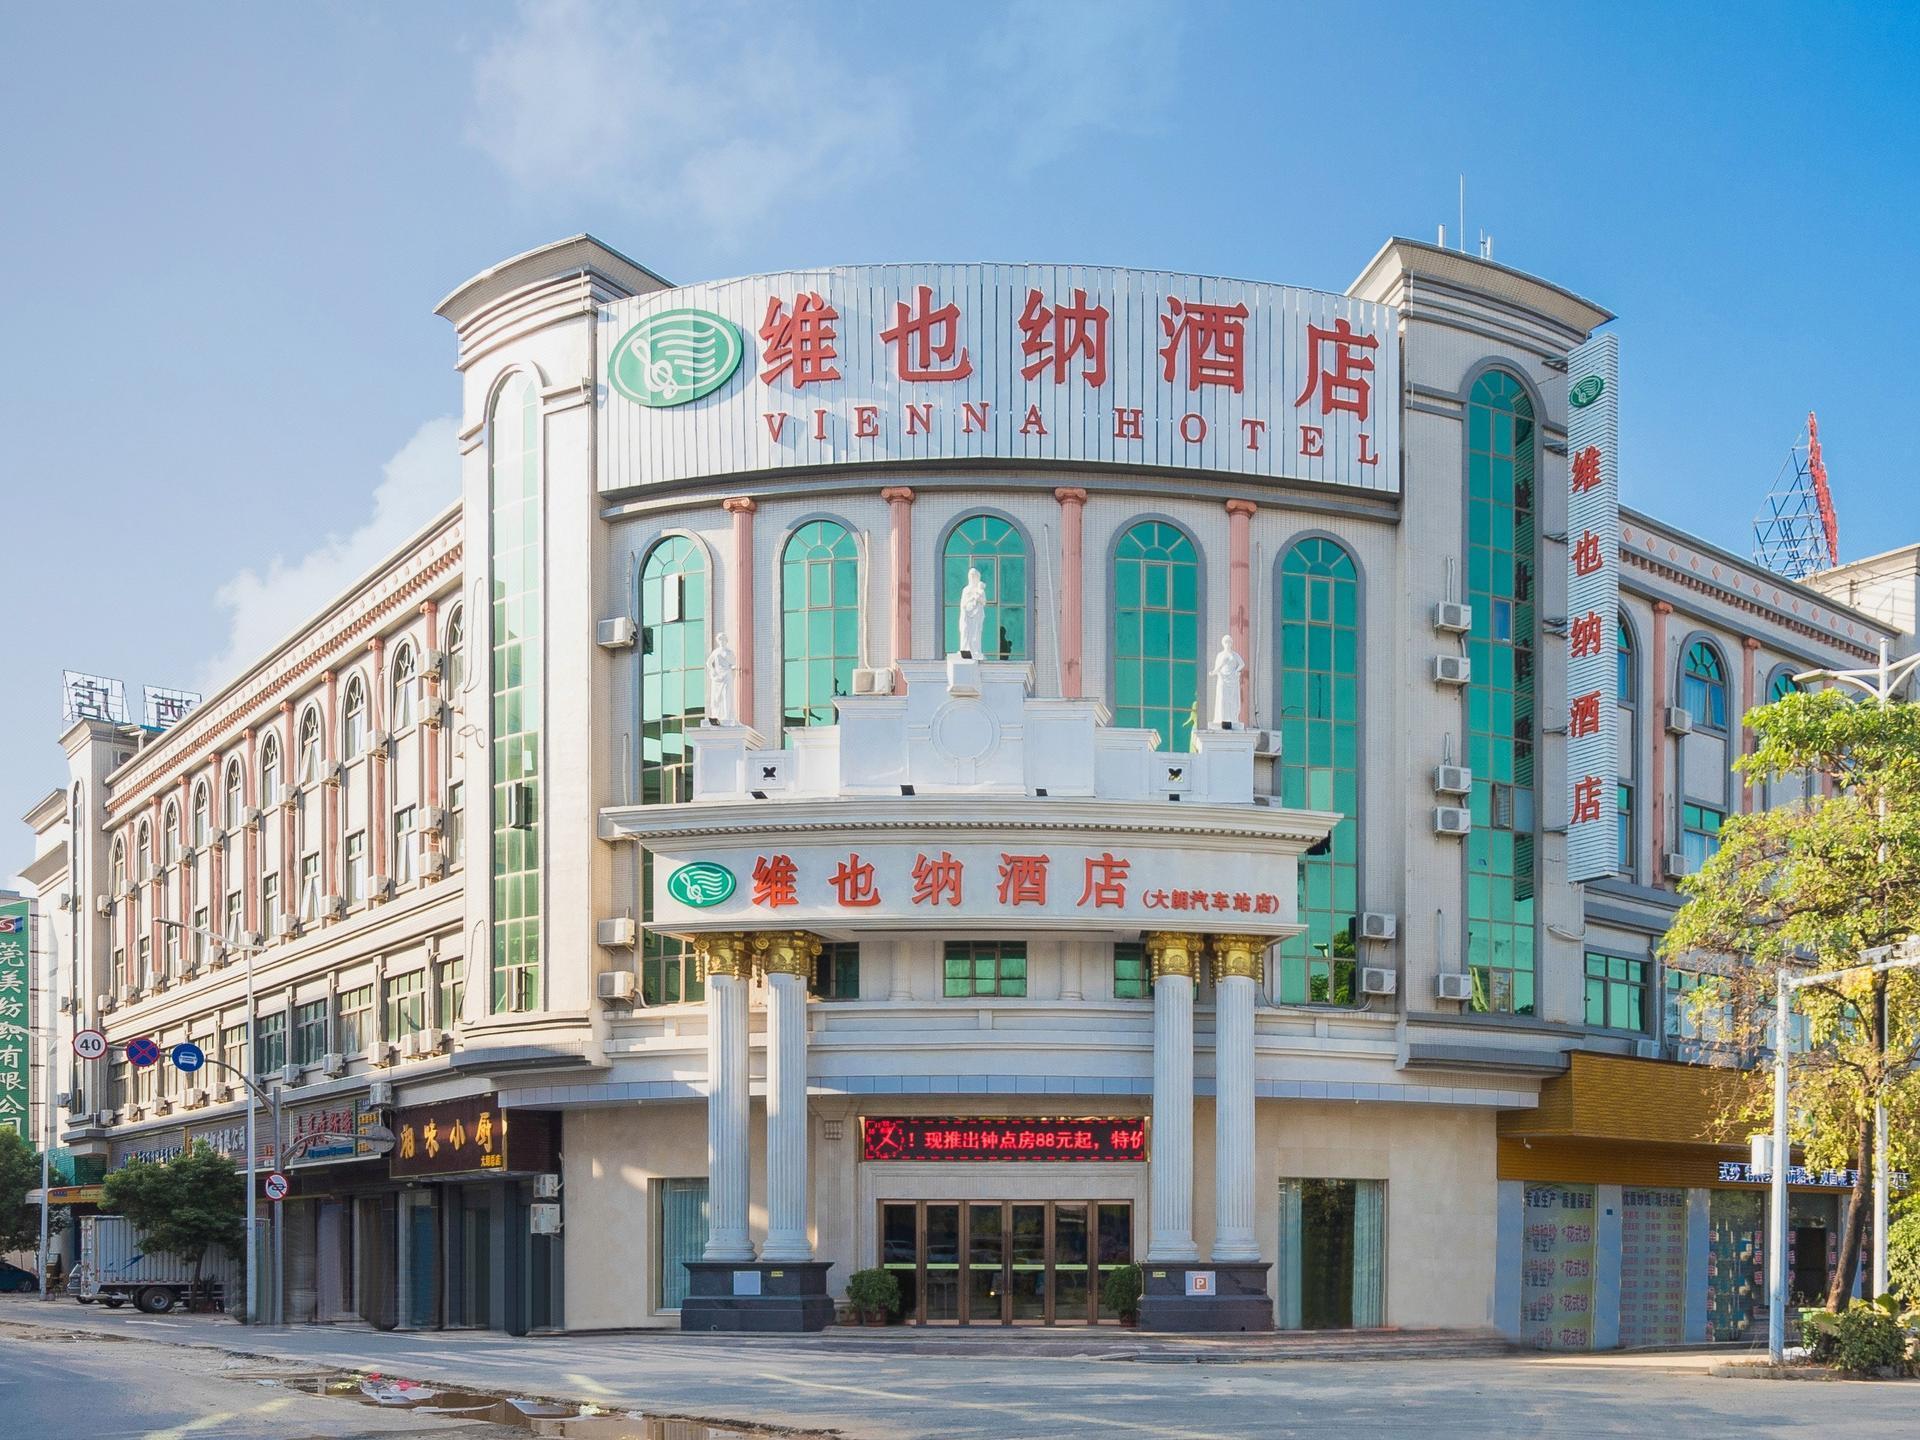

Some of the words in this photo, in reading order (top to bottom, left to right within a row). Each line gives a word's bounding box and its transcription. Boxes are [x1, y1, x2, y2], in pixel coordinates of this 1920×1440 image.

[759, 284, 1379, 422] 维也纳酒店
[763, 402, 1048, 441] VIENNA
[1113, 408, 1379, 465] HOTEL
[1570, 446, 1603, 825] 维也纳酒店
[751, 852, 1132, 908] 维也纳酒店
[80, 1038, 101, 1051] 40
